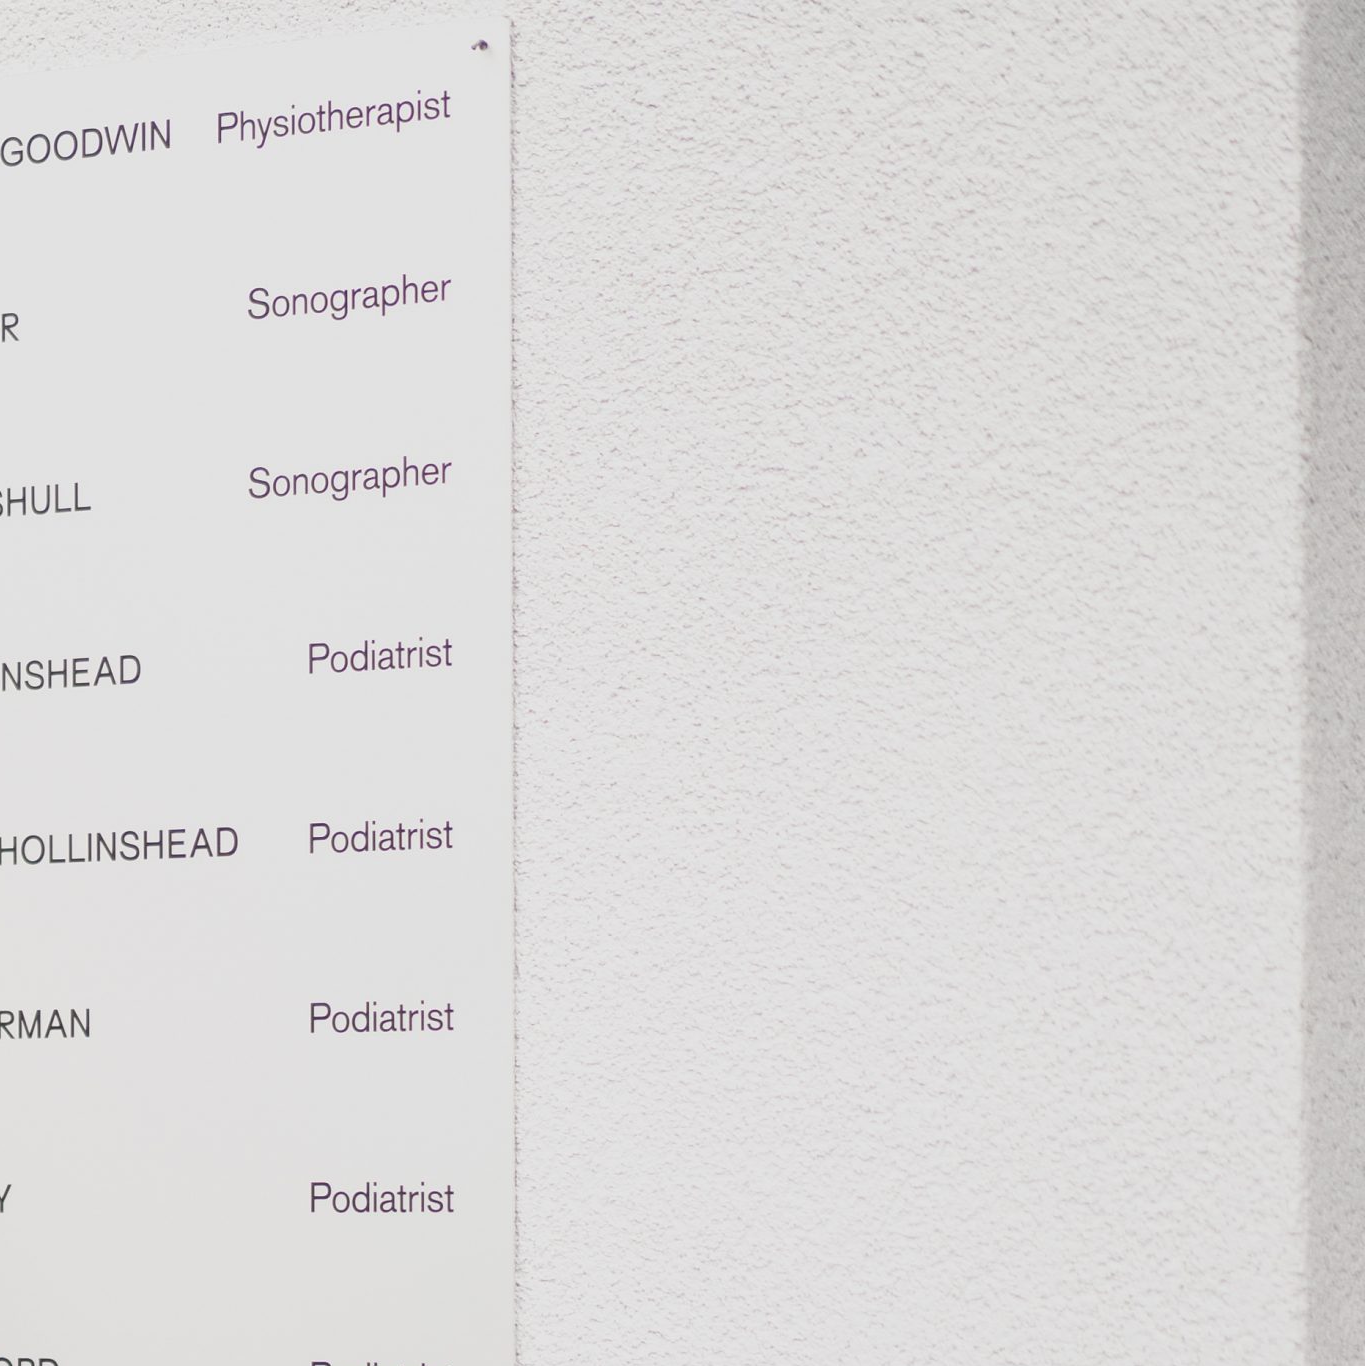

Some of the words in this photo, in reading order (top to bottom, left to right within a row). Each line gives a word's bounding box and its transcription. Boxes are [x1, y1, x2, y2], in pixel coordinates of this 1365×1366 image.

[217, 89, 451, 149] Physiotherapist
[247, 273, 452, 321] Sonographer
[248, 455, 453, 502] Sonographer
[308, 636, 453, 675] Podiatrist
[309, 818, 454, 854] Podiatrist
[310, 999, 455, 1034] Podiatrist
[310, 1181, 455, 1214] Podiatrist
